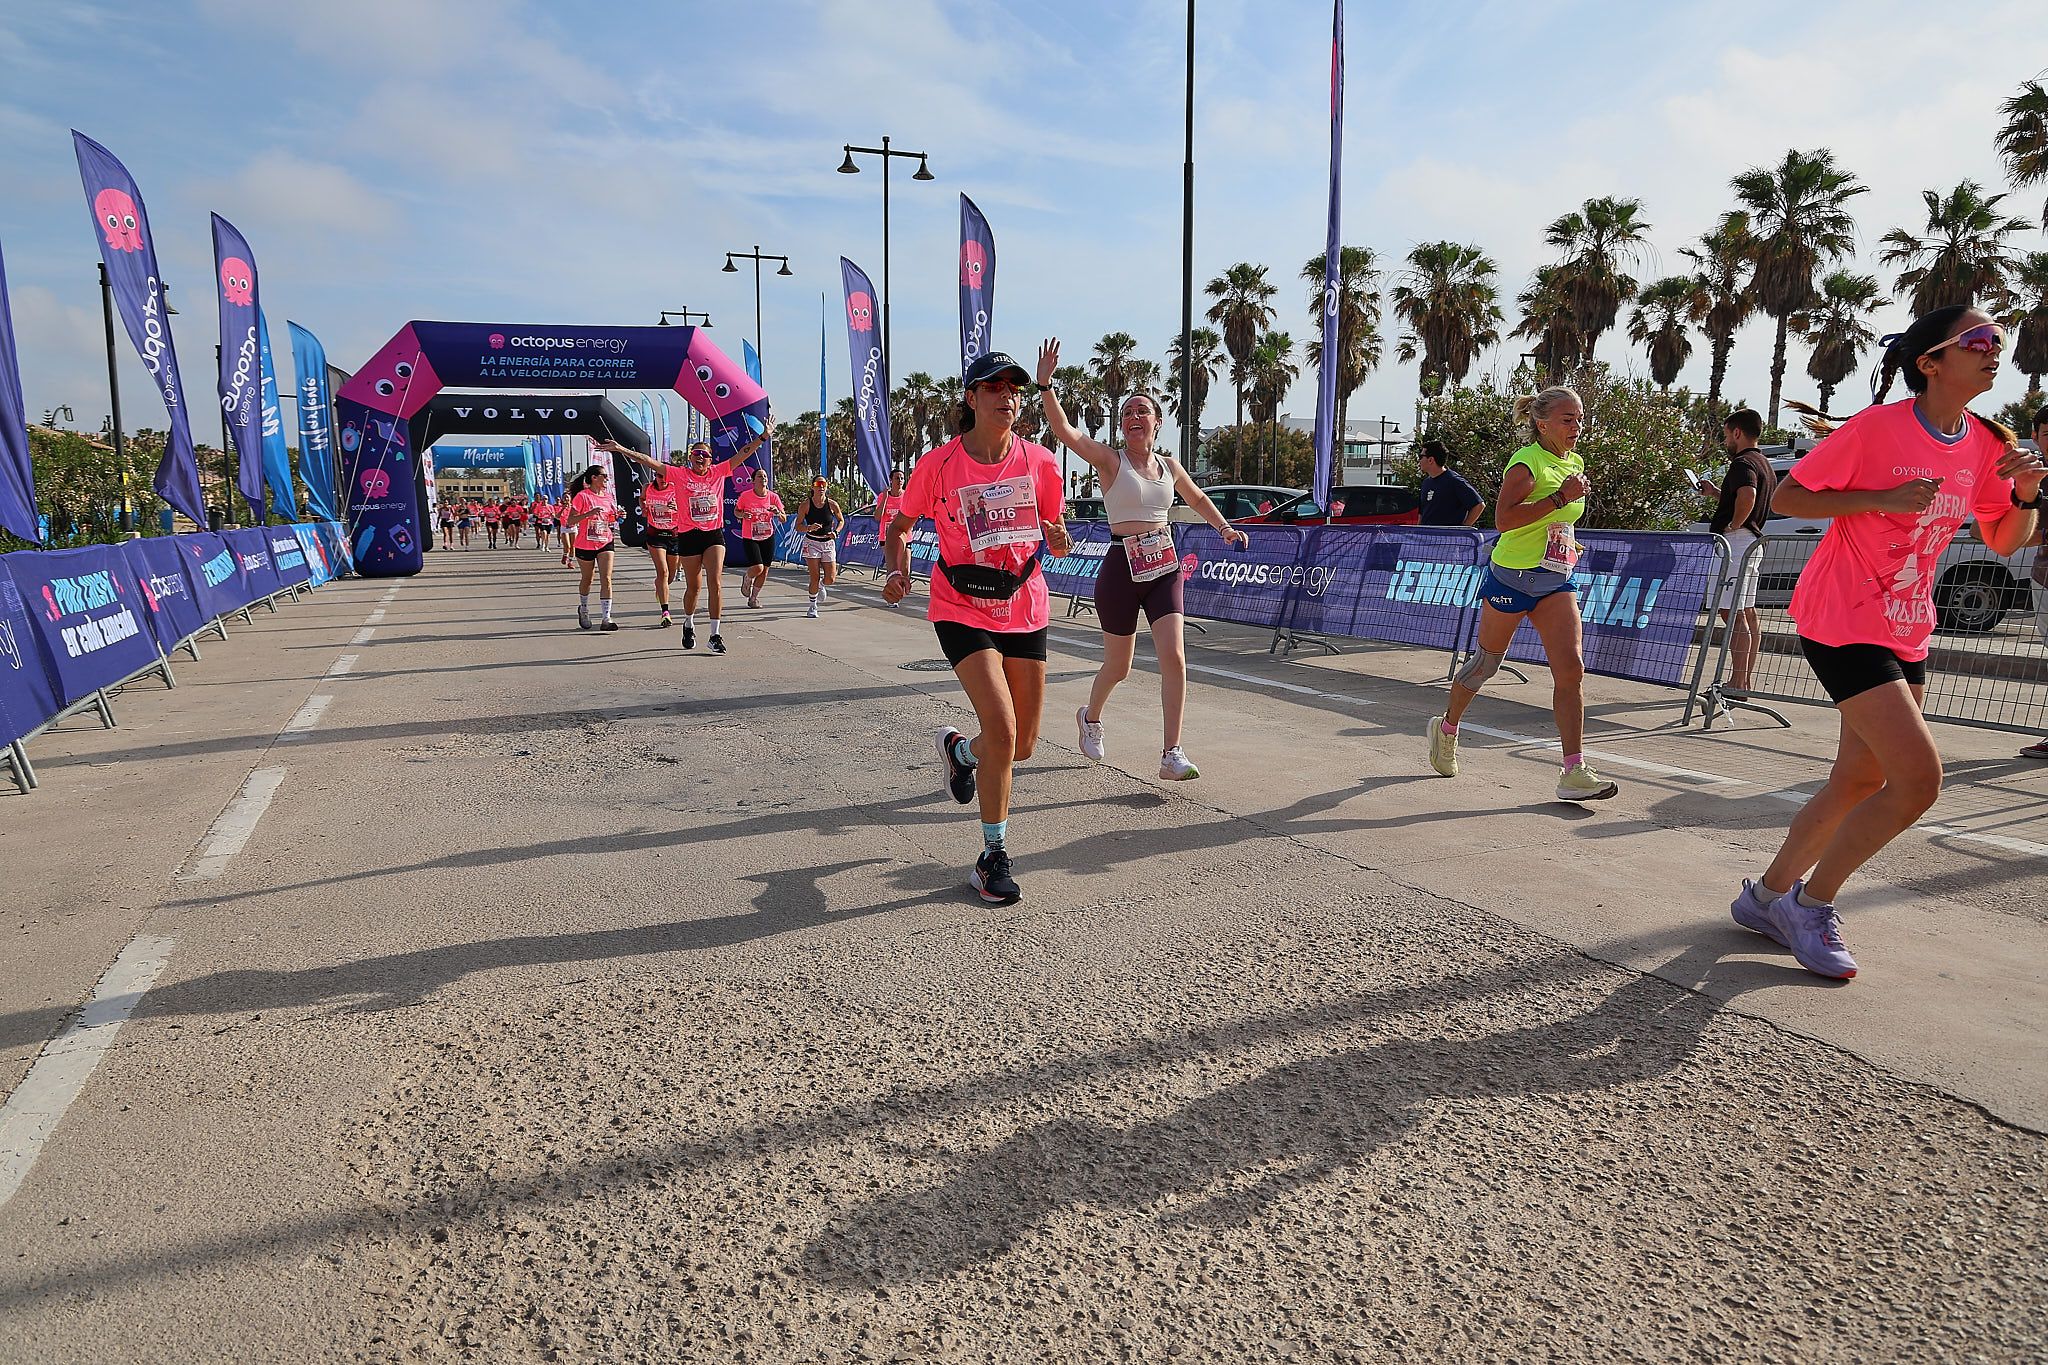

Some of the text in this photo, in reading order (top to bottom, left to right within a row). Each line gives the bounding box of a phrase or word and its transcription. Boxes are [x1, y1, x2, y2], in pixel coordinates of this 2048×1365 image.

[510, 336, 628, 354] octopus energy
[480, 355, 634, 368] LA ENERGÍA PARA CORRER
[479, 369, 637, 379] A LA VELOCIDAD DE LA LUZ
[453, 407, 578, 420] VOLVO
[463, 448, 505, 466] Marlene
[1892, 466, 1933, 477] OYSHO
[988, 507, 1016, 521] 016
[1145, 550, 1163, 563] 016
[1201, 559, 1269, 588] octopus
[1268, 565, 1337, 597] energy
